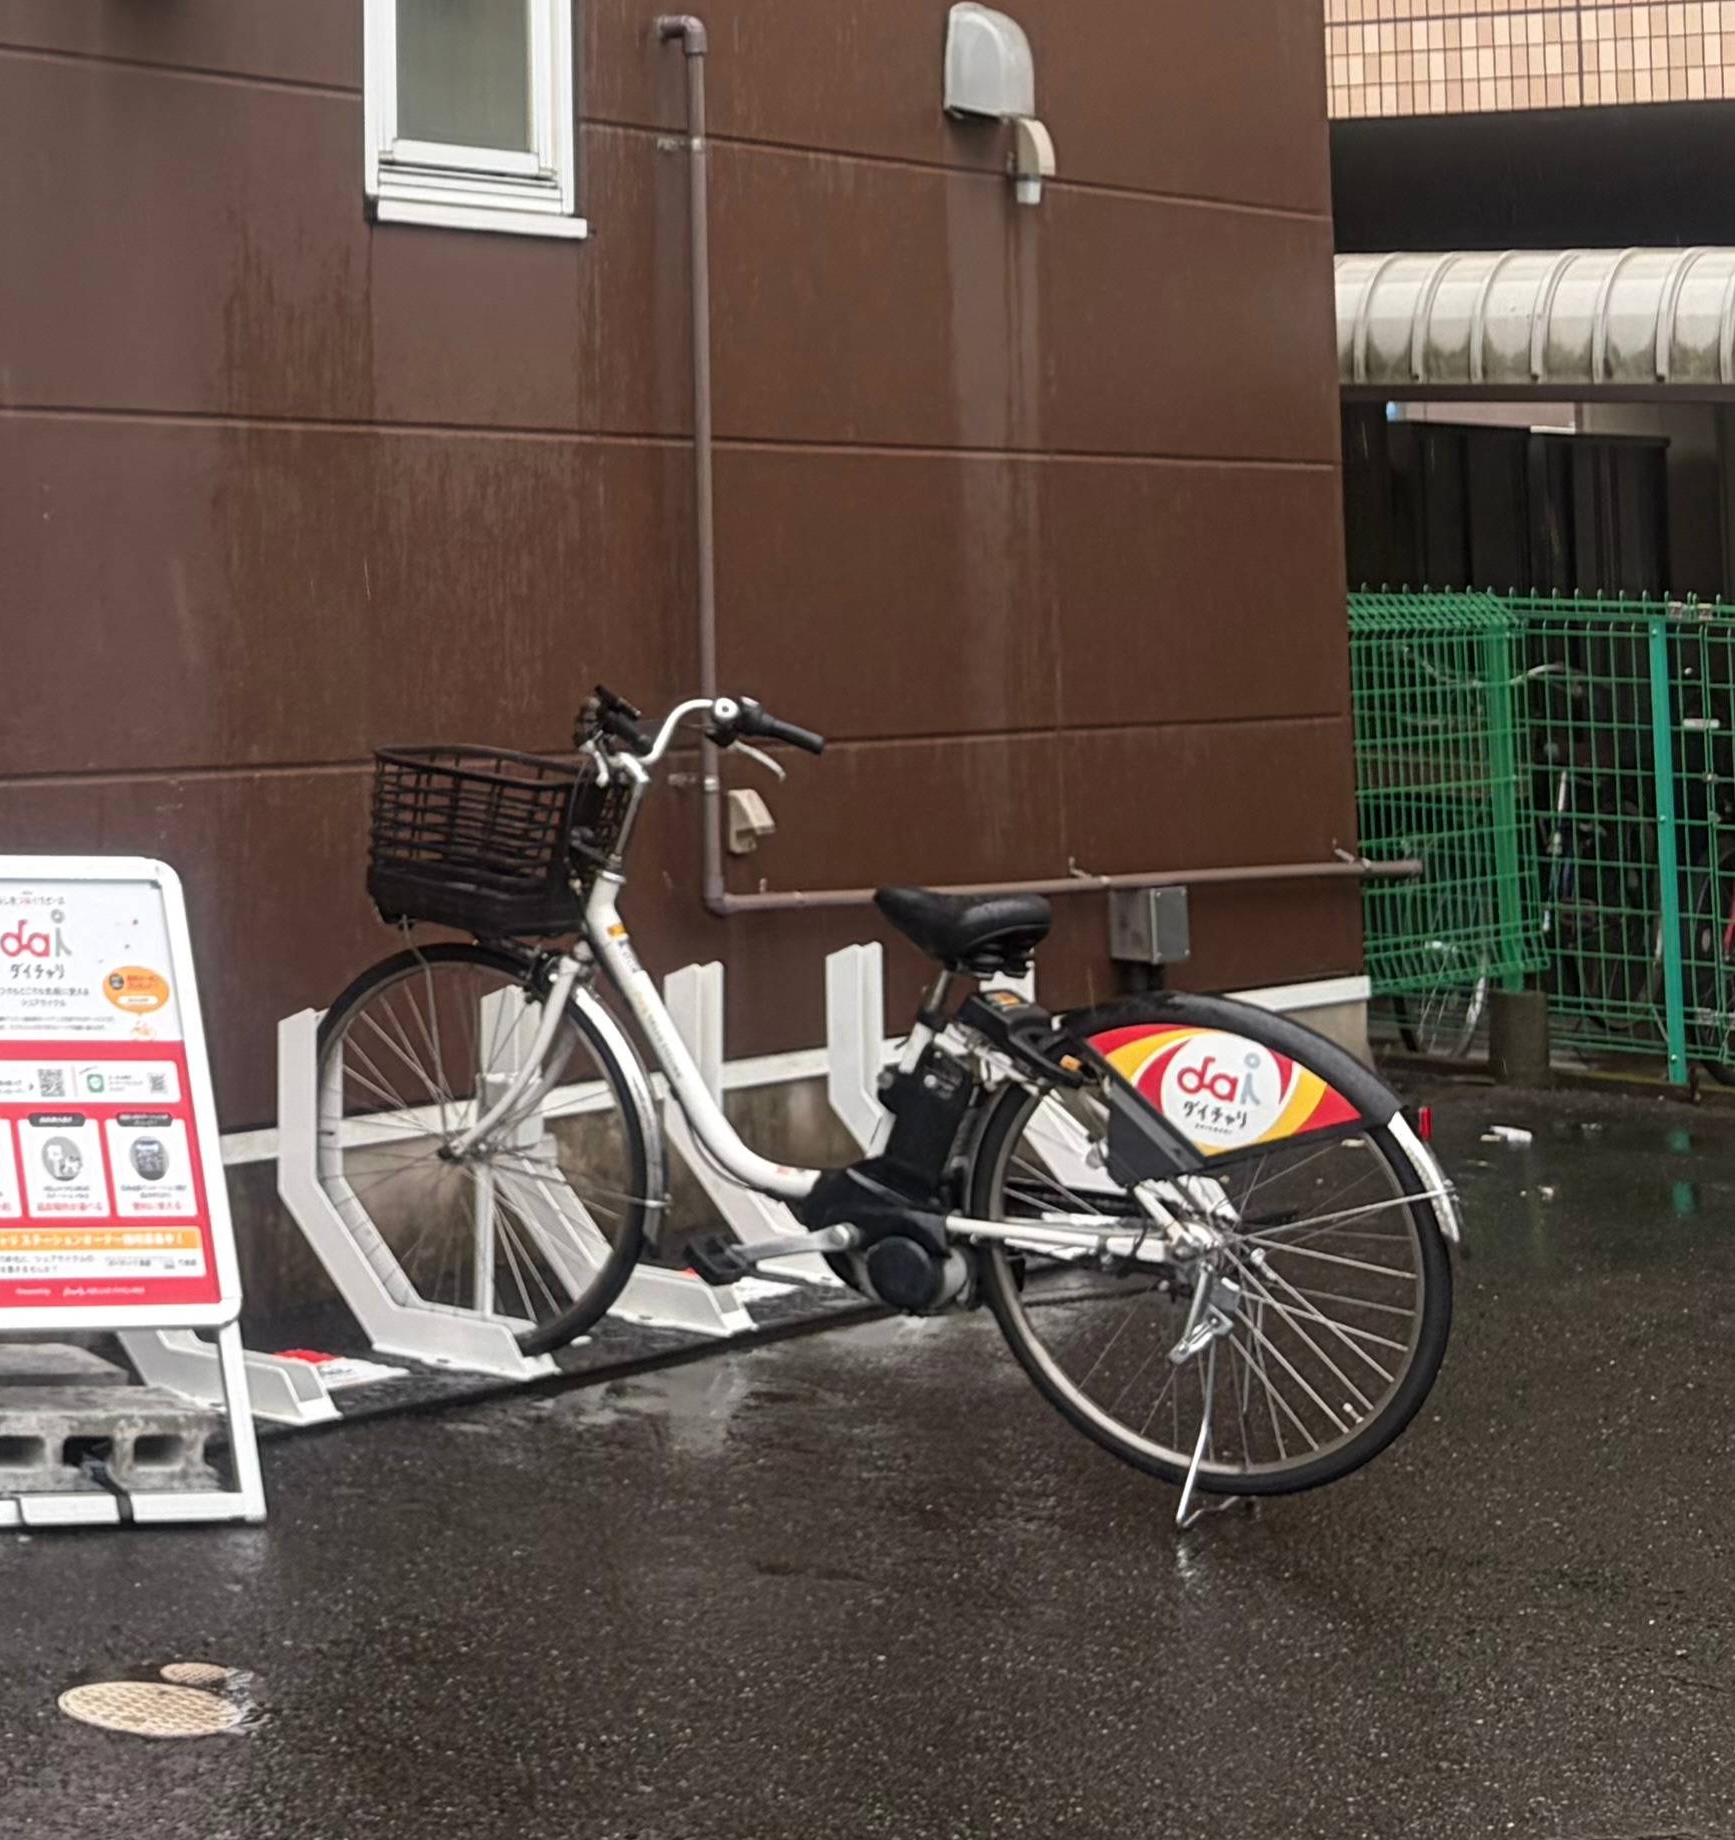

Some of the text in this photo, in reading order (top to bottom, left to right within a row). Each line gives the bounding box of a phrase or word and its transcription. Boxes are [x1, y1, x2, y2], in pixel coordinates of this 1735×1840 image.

[0, 908, 72, 957] dai
[10, 963, 65, 980] ダイチャリ
[1177, 1052, 1261, 1105] dai
[1183, 1099, 1248, 1129] ダイチャリ
